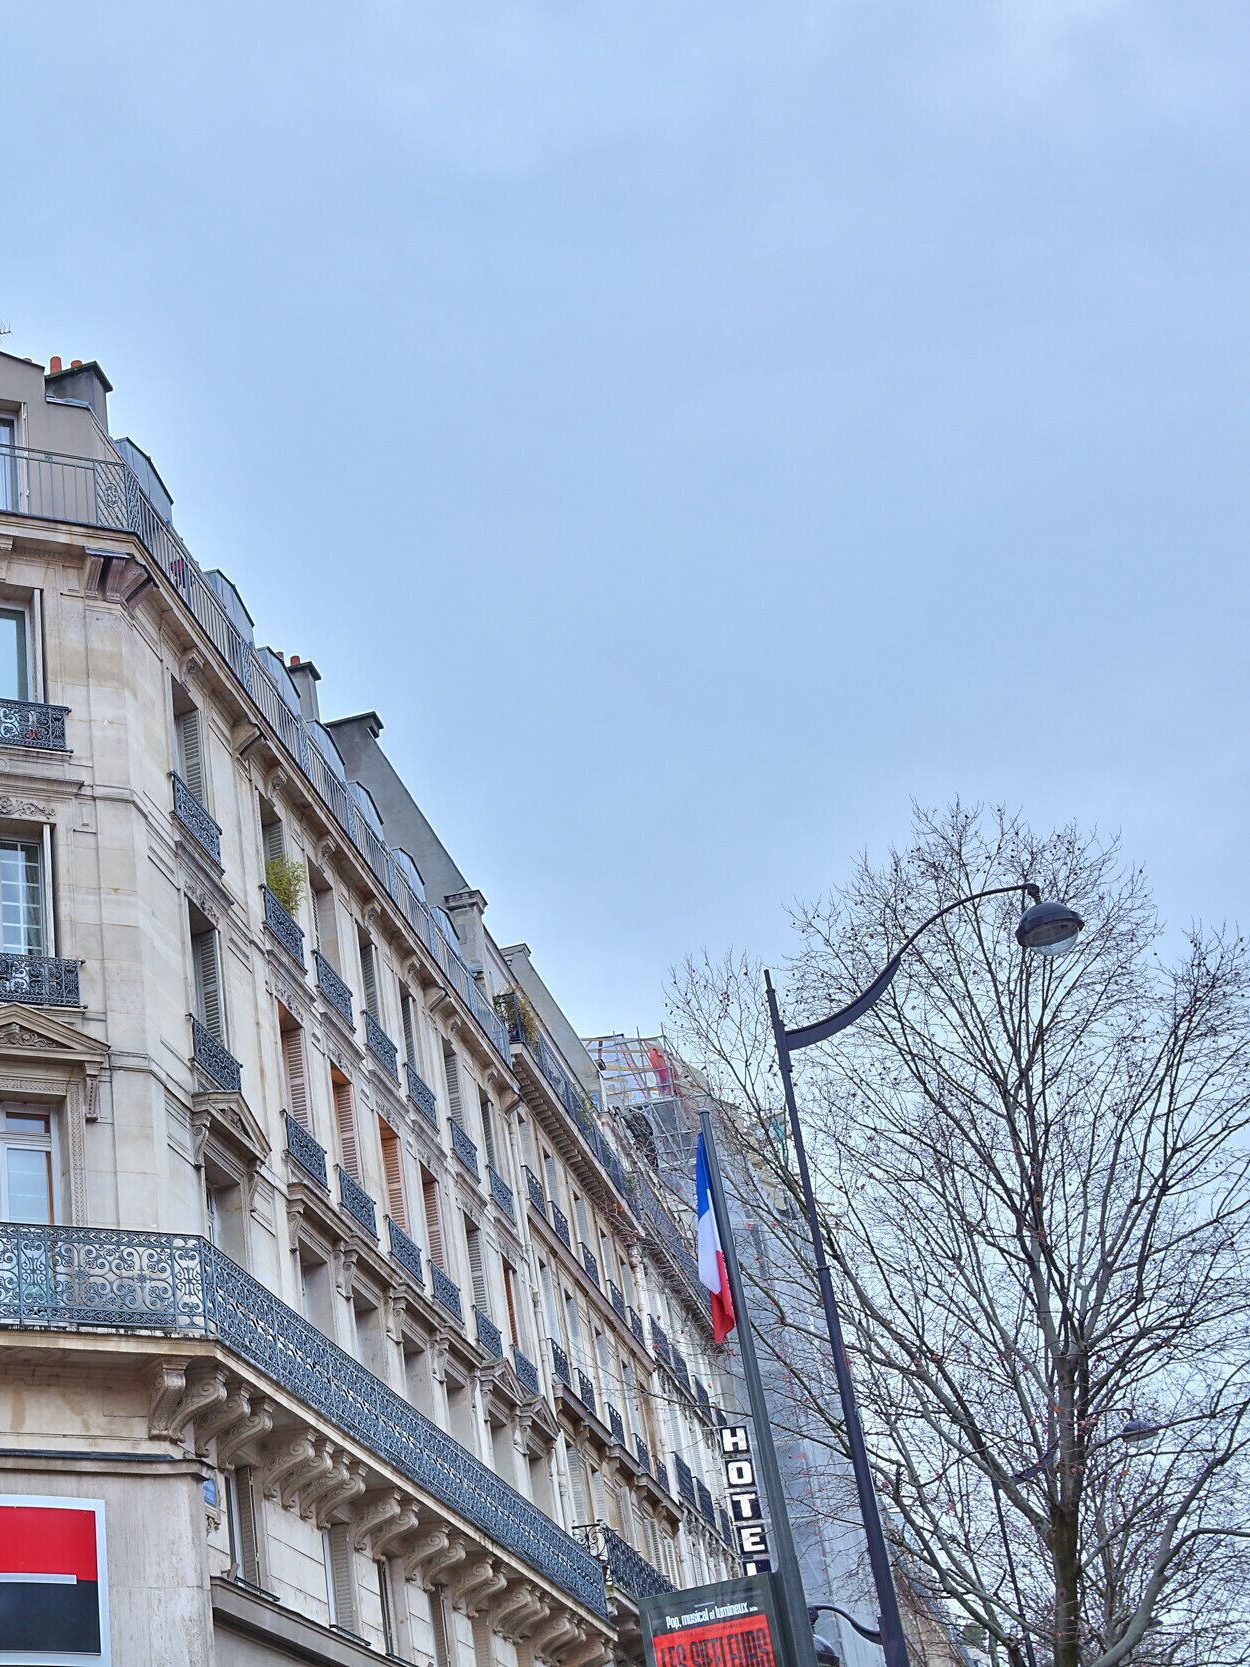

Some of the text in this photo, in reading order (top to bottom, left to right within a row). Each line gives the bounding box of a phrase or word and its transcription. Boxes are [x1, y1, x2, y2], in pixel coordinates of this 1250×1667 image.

[665, 1615, 682, 1630] Pop,
[681, 1607, 709, 1626] musical
[708, 1610, 716, 1621] et
[715, 1602, 749, 1619] lumineux
